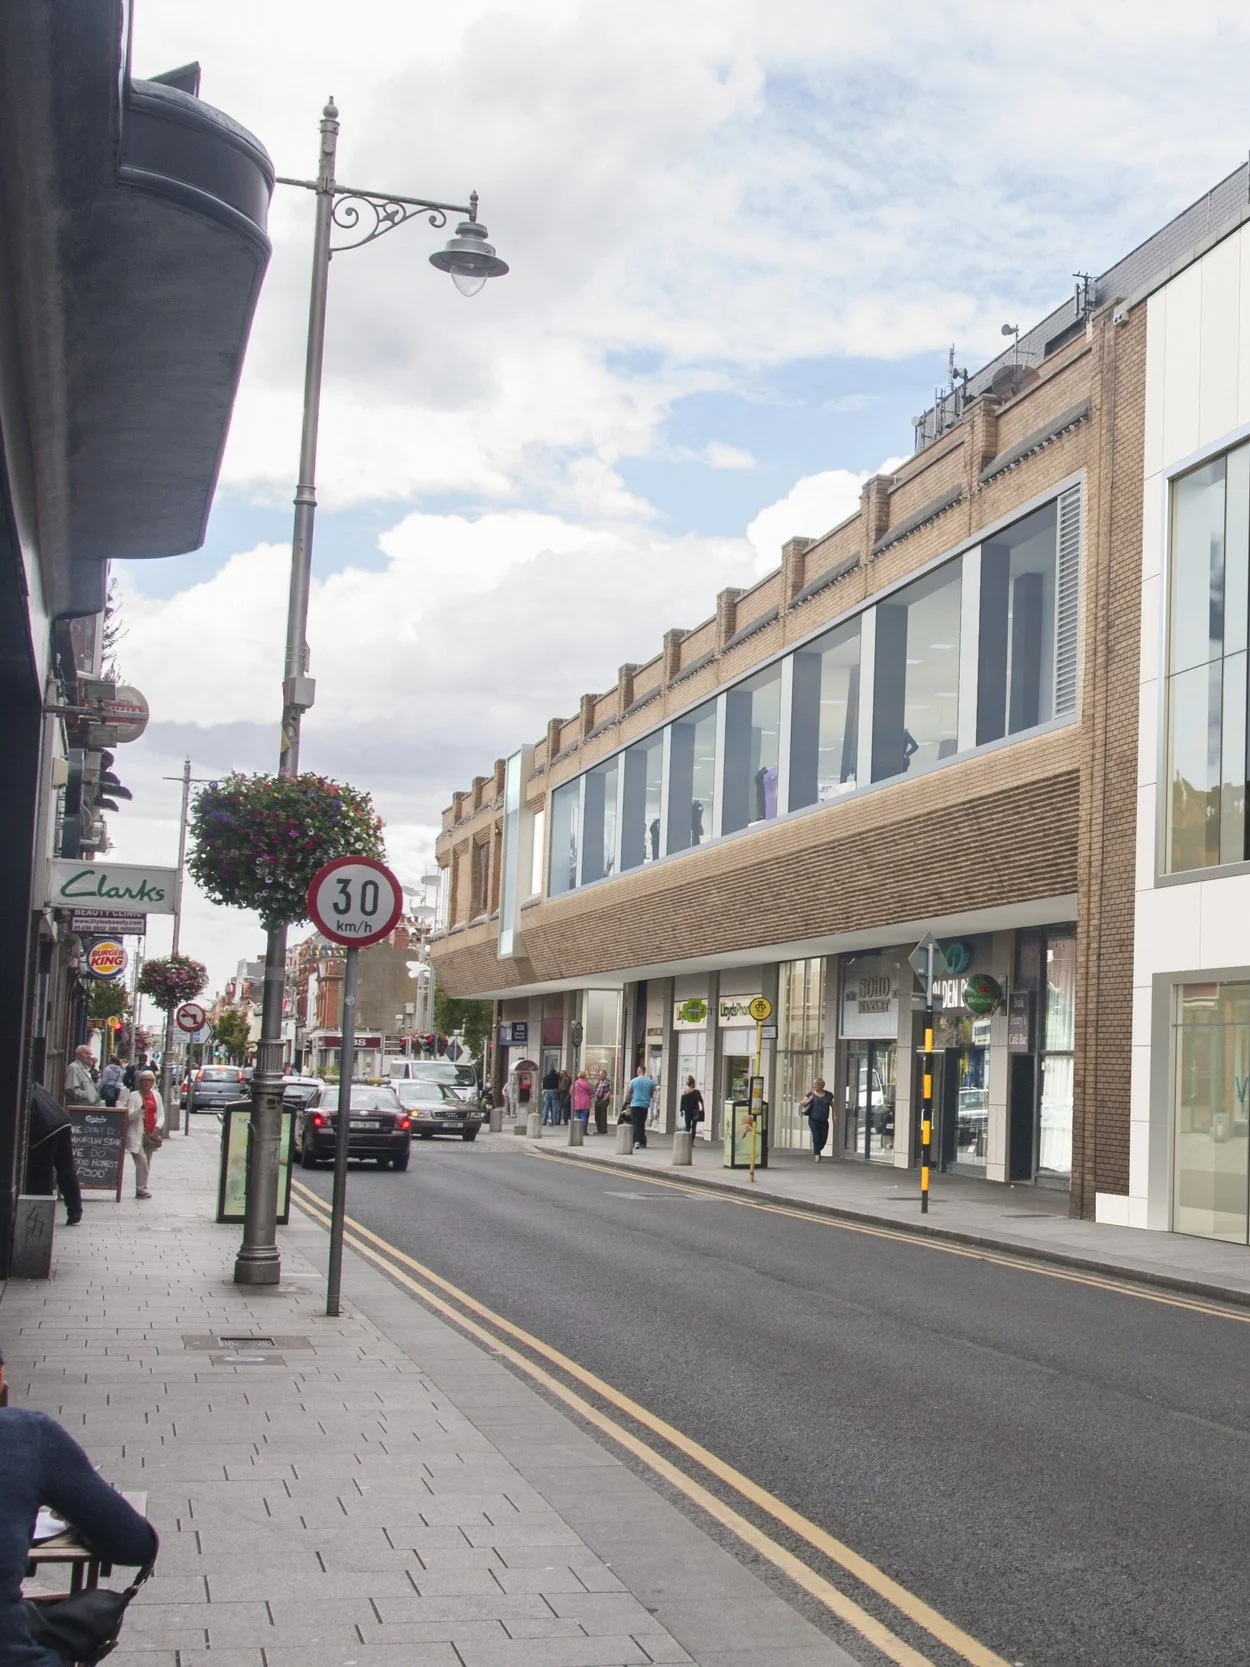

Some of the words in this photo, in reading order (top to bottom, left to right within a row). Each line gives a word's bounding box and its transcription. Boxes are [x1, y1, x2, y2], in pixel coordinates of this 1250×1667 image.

[60, 869, 165, 902] Clarks
[333, 878, 379, 917] 30
[336, 920, 372, 934] km/h
[92, 949, 124, 957] BURGER
[91, 956, 124, 967] KING
[720, 1001, 749, 1020] LloydsPhar
[92, 1158, 119, 1168] HONEST
